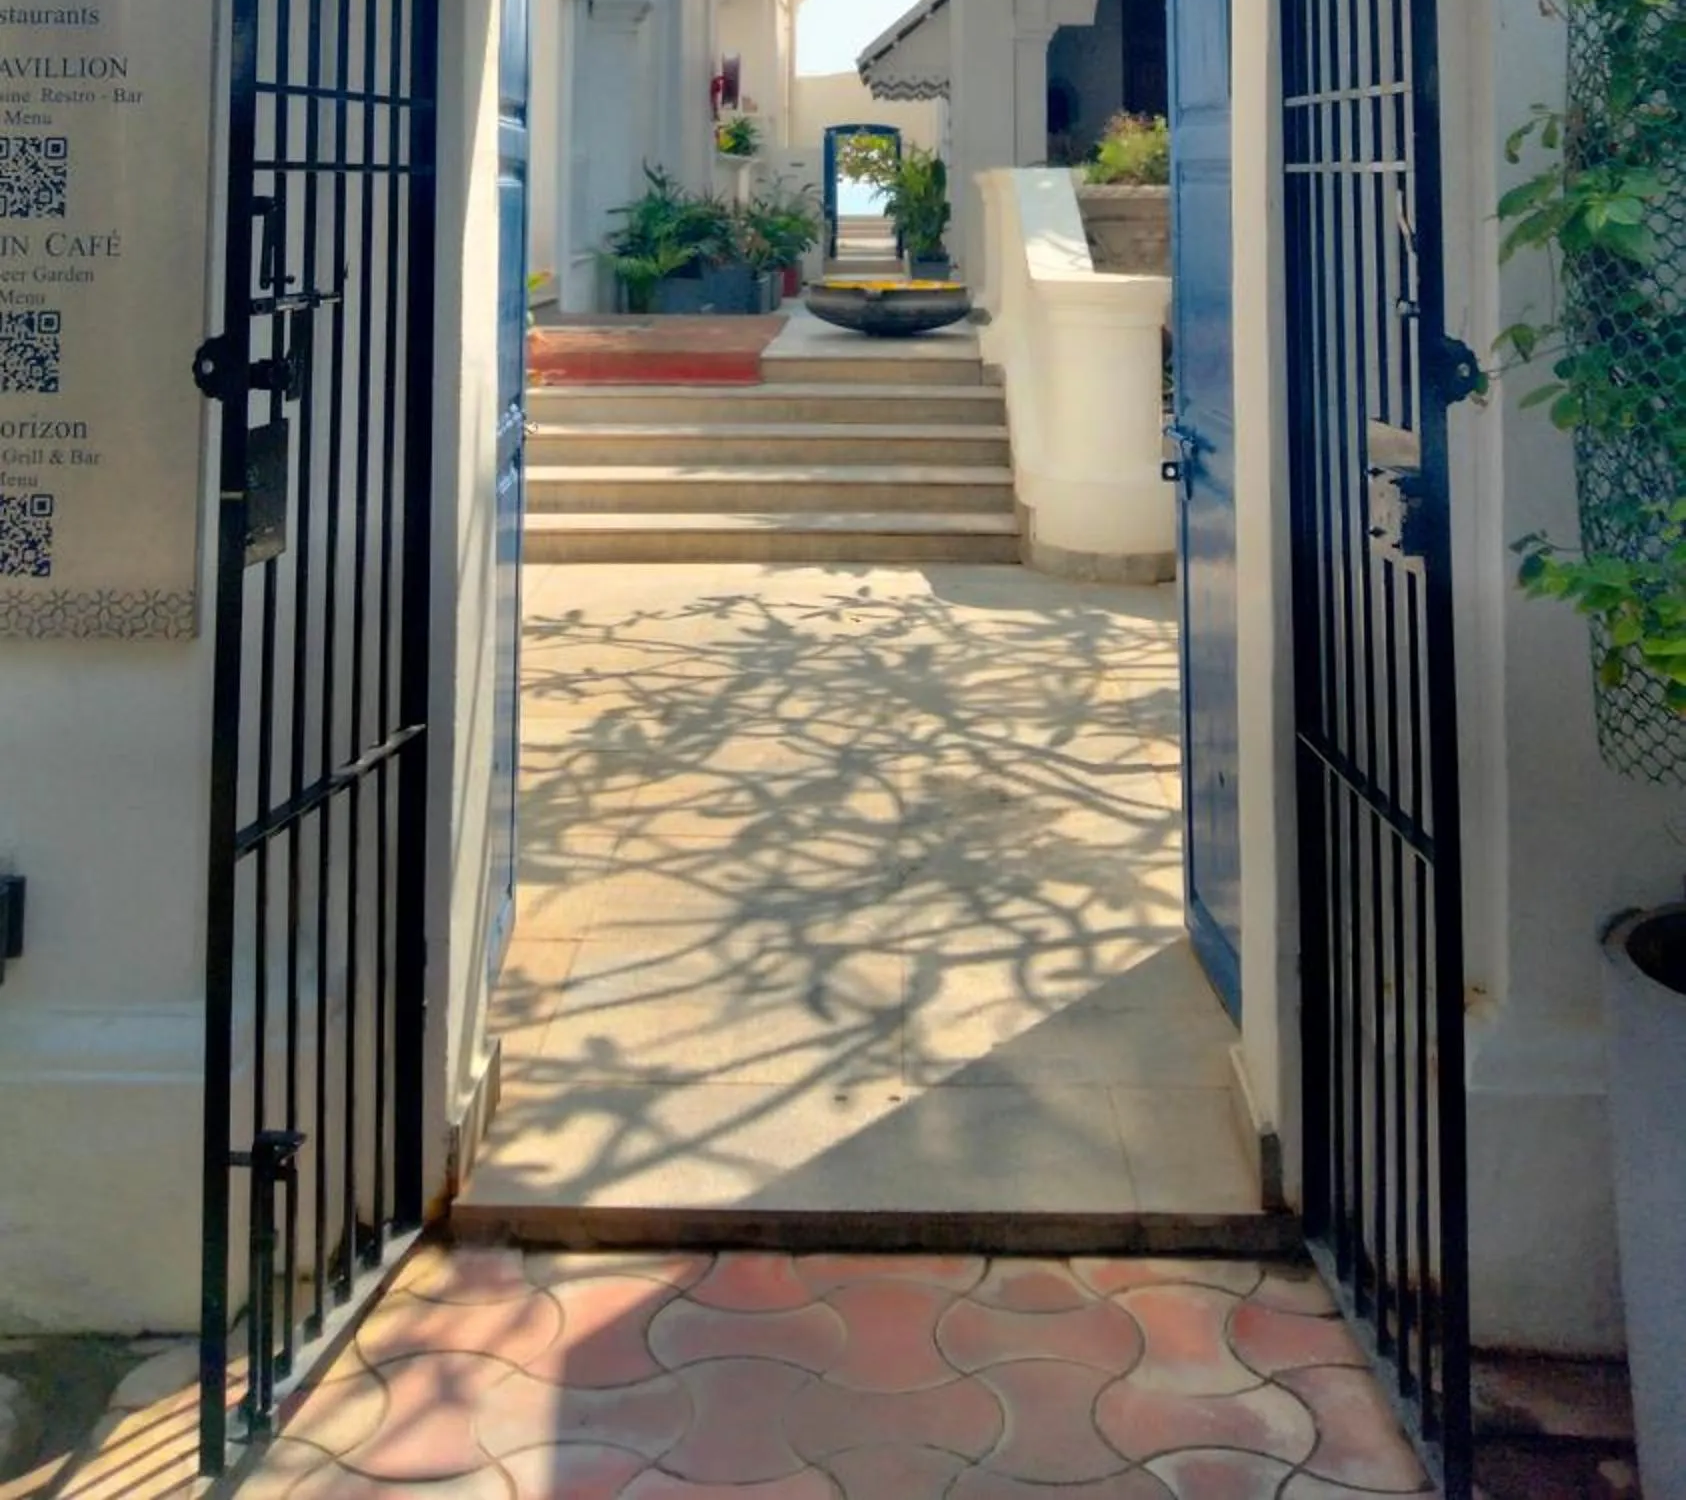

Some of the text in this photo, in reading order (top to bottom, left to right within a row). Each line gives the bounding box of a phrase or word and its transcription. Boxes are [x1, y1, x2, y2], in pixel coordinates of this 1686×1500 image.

[3, 109, 53, 126] Menu
[33, 265, 95, 284] Garden
[0, 413, 88, 440] orizon
[49, 449, 65, 466] &
[69, 448, 102, 466] Bar
